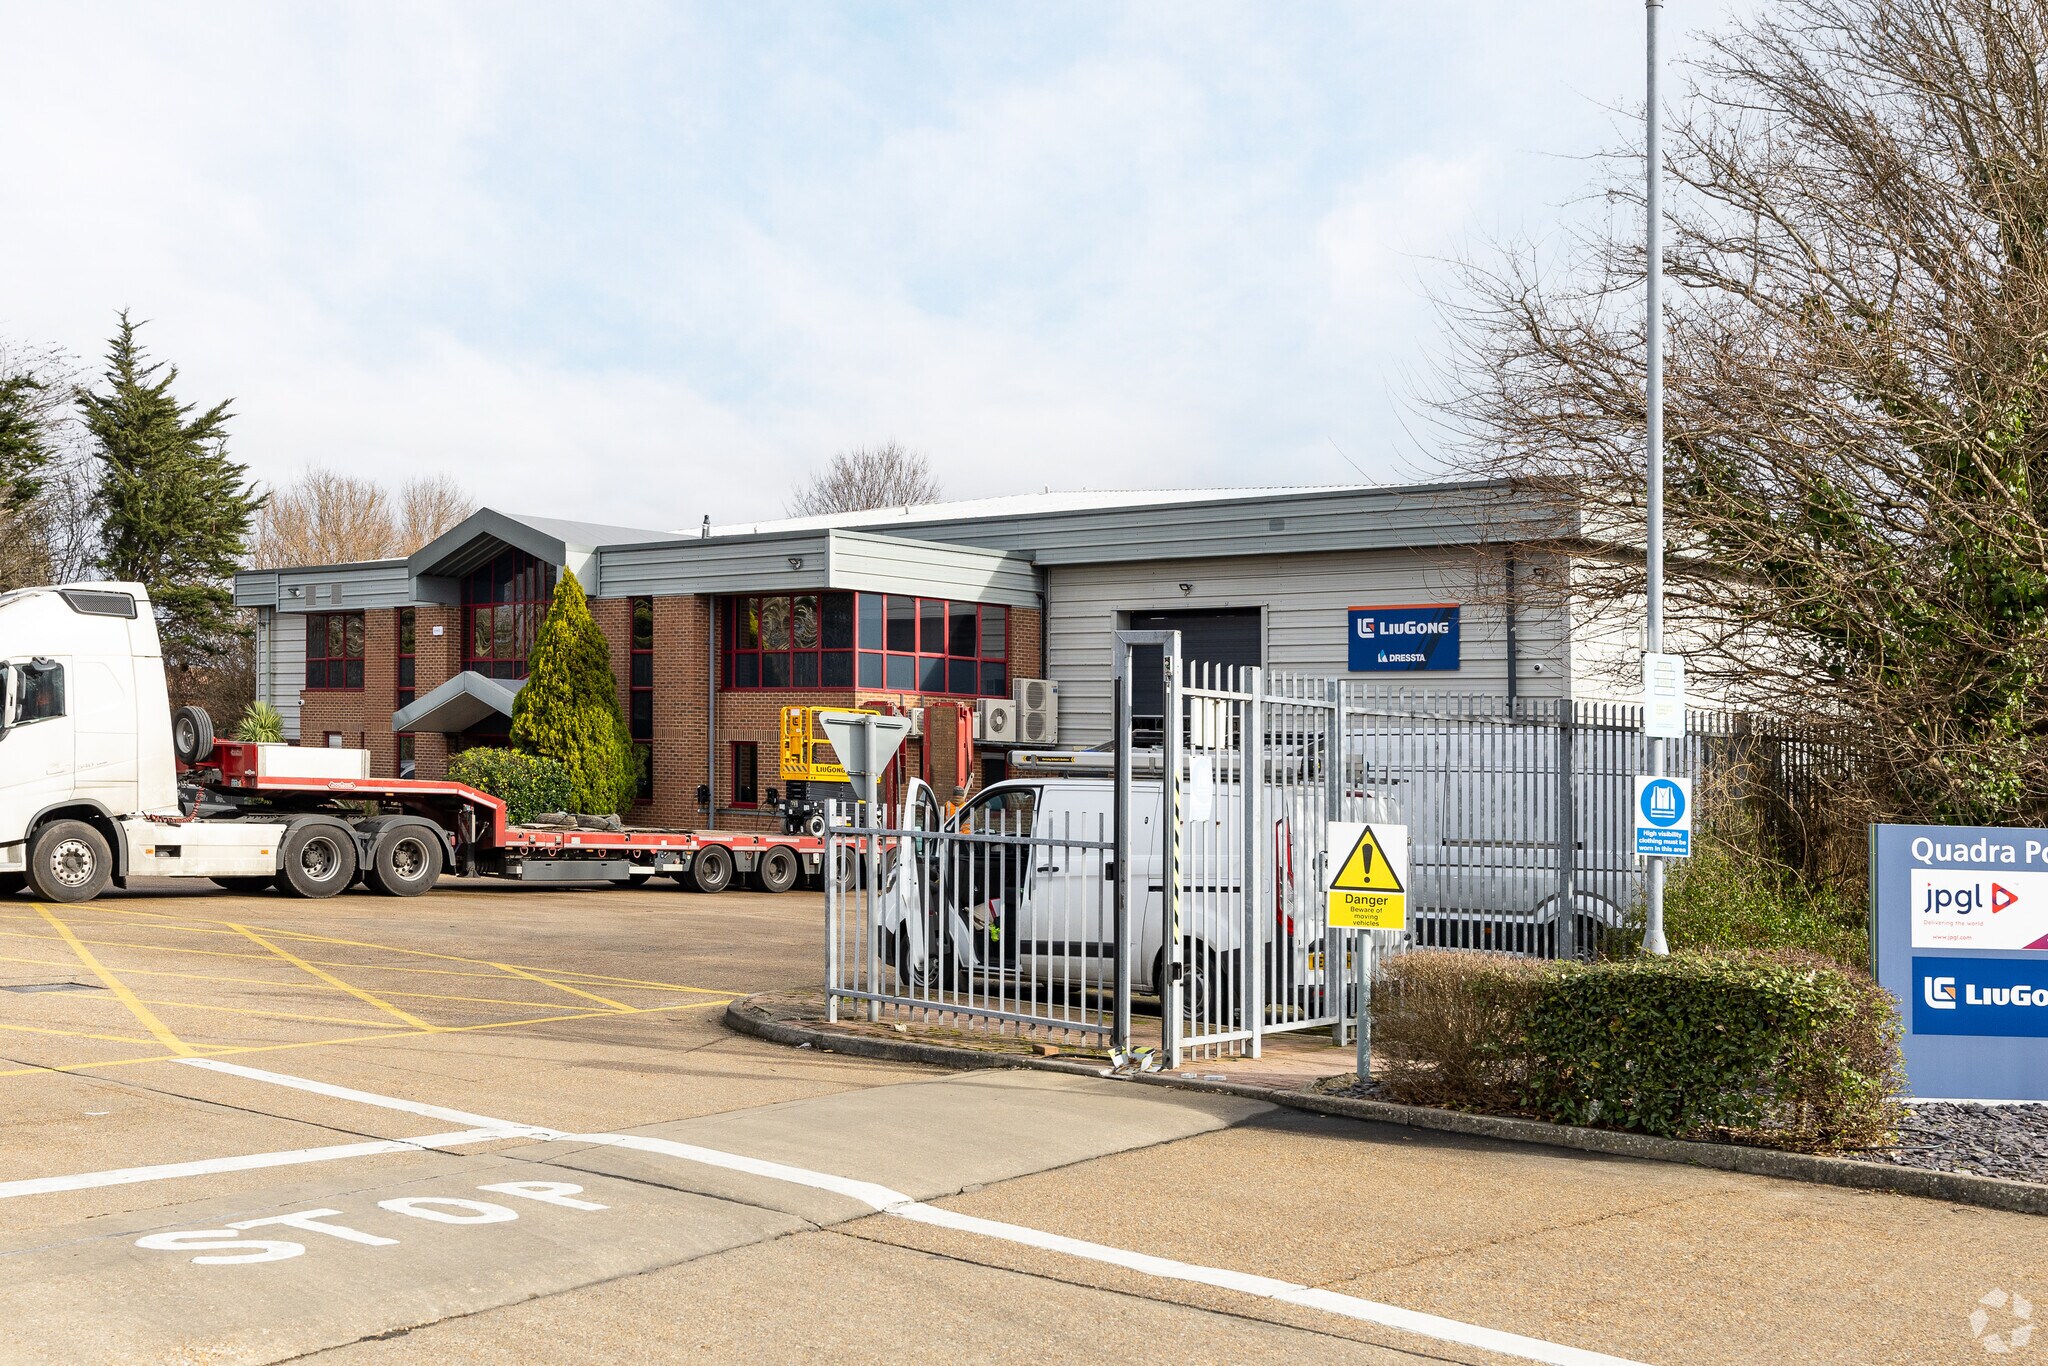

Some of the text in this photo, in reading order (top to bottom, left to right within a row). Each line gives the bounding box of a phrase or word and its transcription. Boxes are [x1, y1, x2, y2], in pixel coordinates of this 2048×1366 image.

[1389, 653, 1426, 662] DRESSTA
[1643, 830, 1657, 838] High
[1911, 836, 2016, 865] Quadra
[1345, 893, 1388, 907] Danger
[1924, 882, 1983, 915] jpgl
[1923, 919, 1954, 927] Delivering
[134, 1181, 611, 1264] STOP
